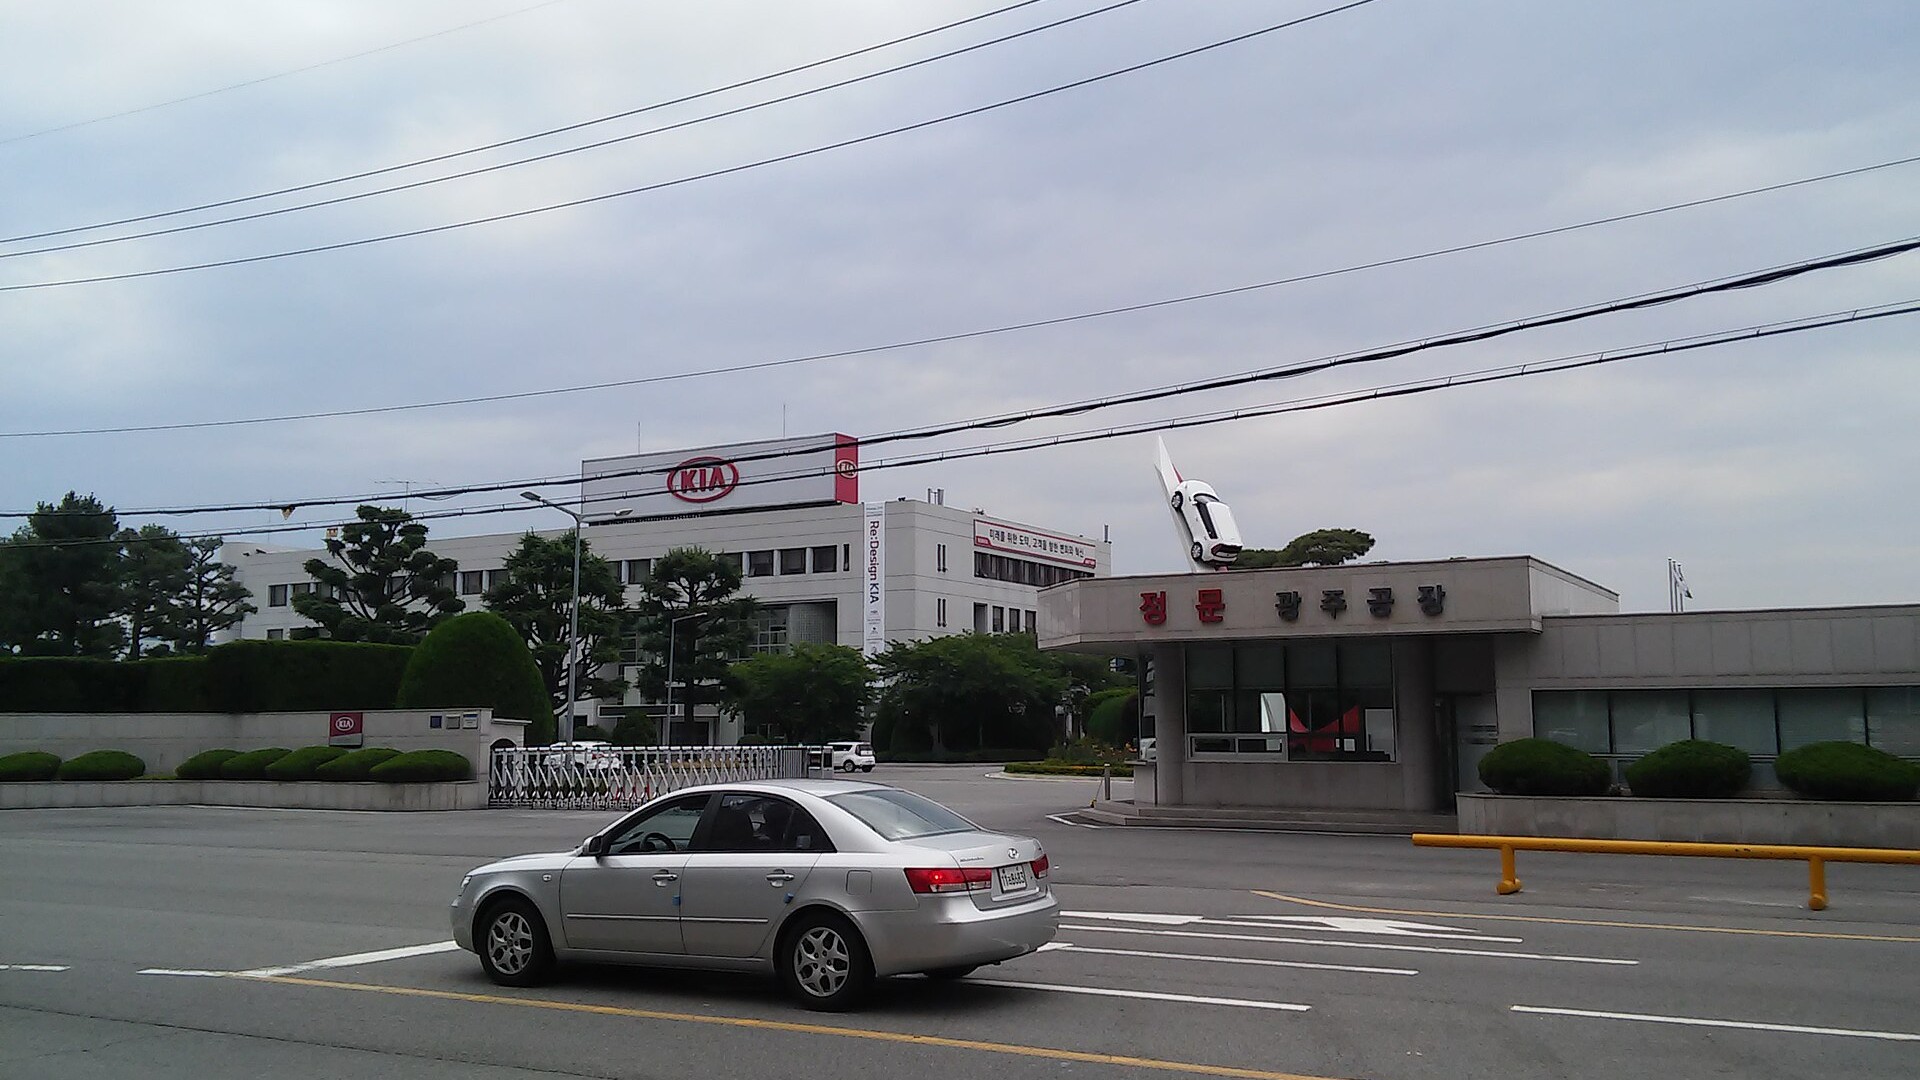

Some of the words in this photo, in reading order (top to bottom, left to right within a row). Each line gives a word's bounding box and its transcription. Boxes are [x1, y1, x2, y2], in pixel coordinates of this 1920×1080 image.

[681, 467, 726, 493] KIA
[868, 521, 879, 581] Re:Design
[869, 583, 879, 604] KIA
[1140, 589, 1226, 625] 정문
[1275, 585, 1446, 622] 광주공장
[338, 719, 351, 728] KIA
